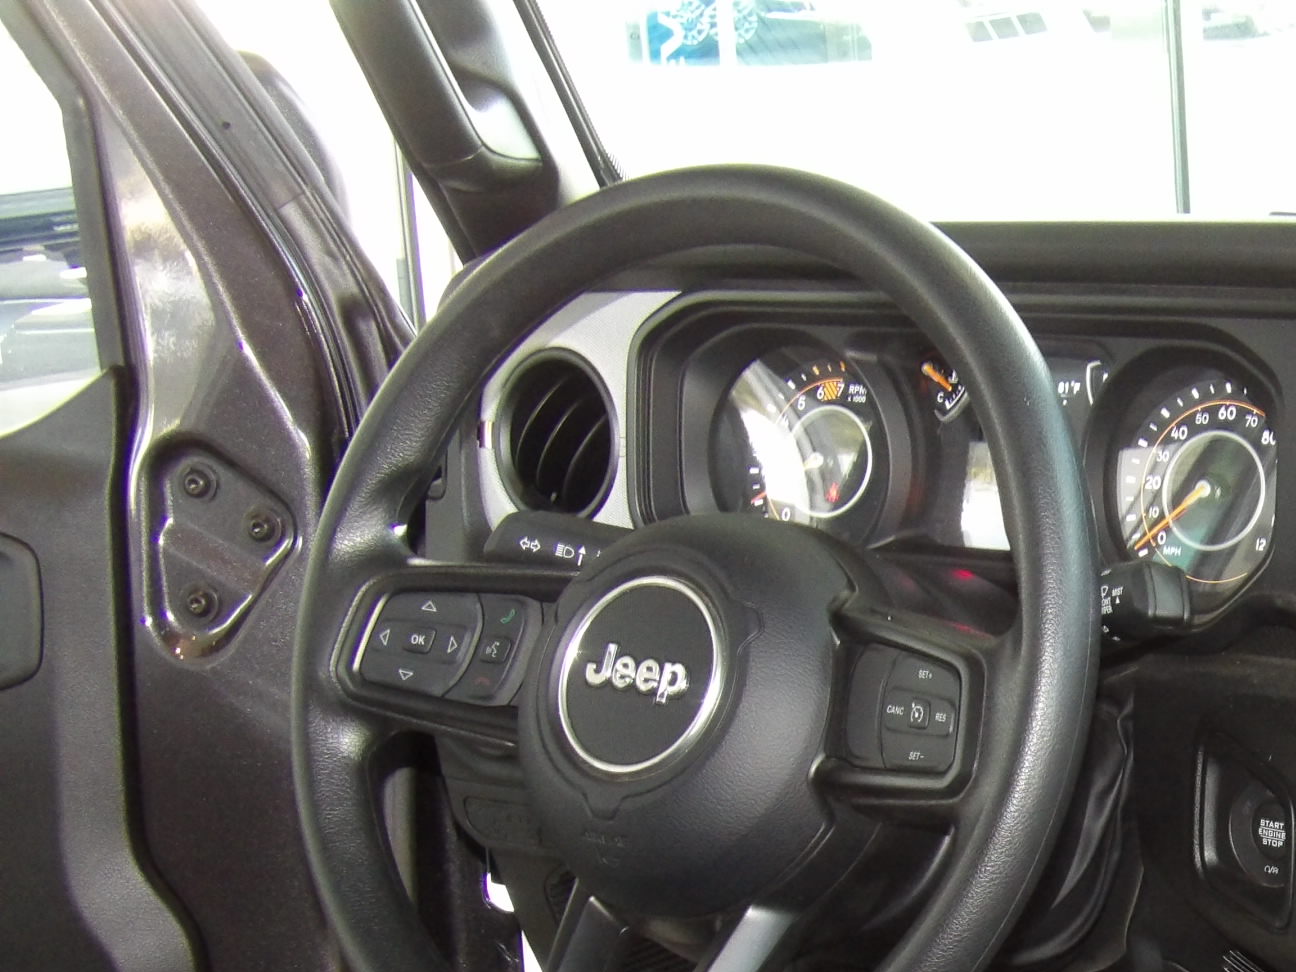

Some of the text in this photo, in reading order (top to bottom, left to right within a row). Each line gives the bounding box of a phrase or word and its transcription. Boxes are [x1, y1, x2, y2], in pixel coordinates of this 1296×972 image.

[1218, 406, 1236, 421] 60
[1245, 414, 1258, 428] 70
[1171, 425, 1188, 441] 40
[1156, 450, 1169, 463] 30
[1145, 475, 1161, 490] 20
[1149, 506, 1159, 519] 10
[1157, 531, 1166, 546] 0
[1162, 546, 1181, 556] MPH
[411, 634, 425, 645] OK
[585, 643, 689, 703] Jeep
[886, 705, 904, 715] CANC
[1260, 819, 1285, 830] START
[1258, 828, 1286, 840] ENGINE
[1262, 838, 1284, 848] STOP
